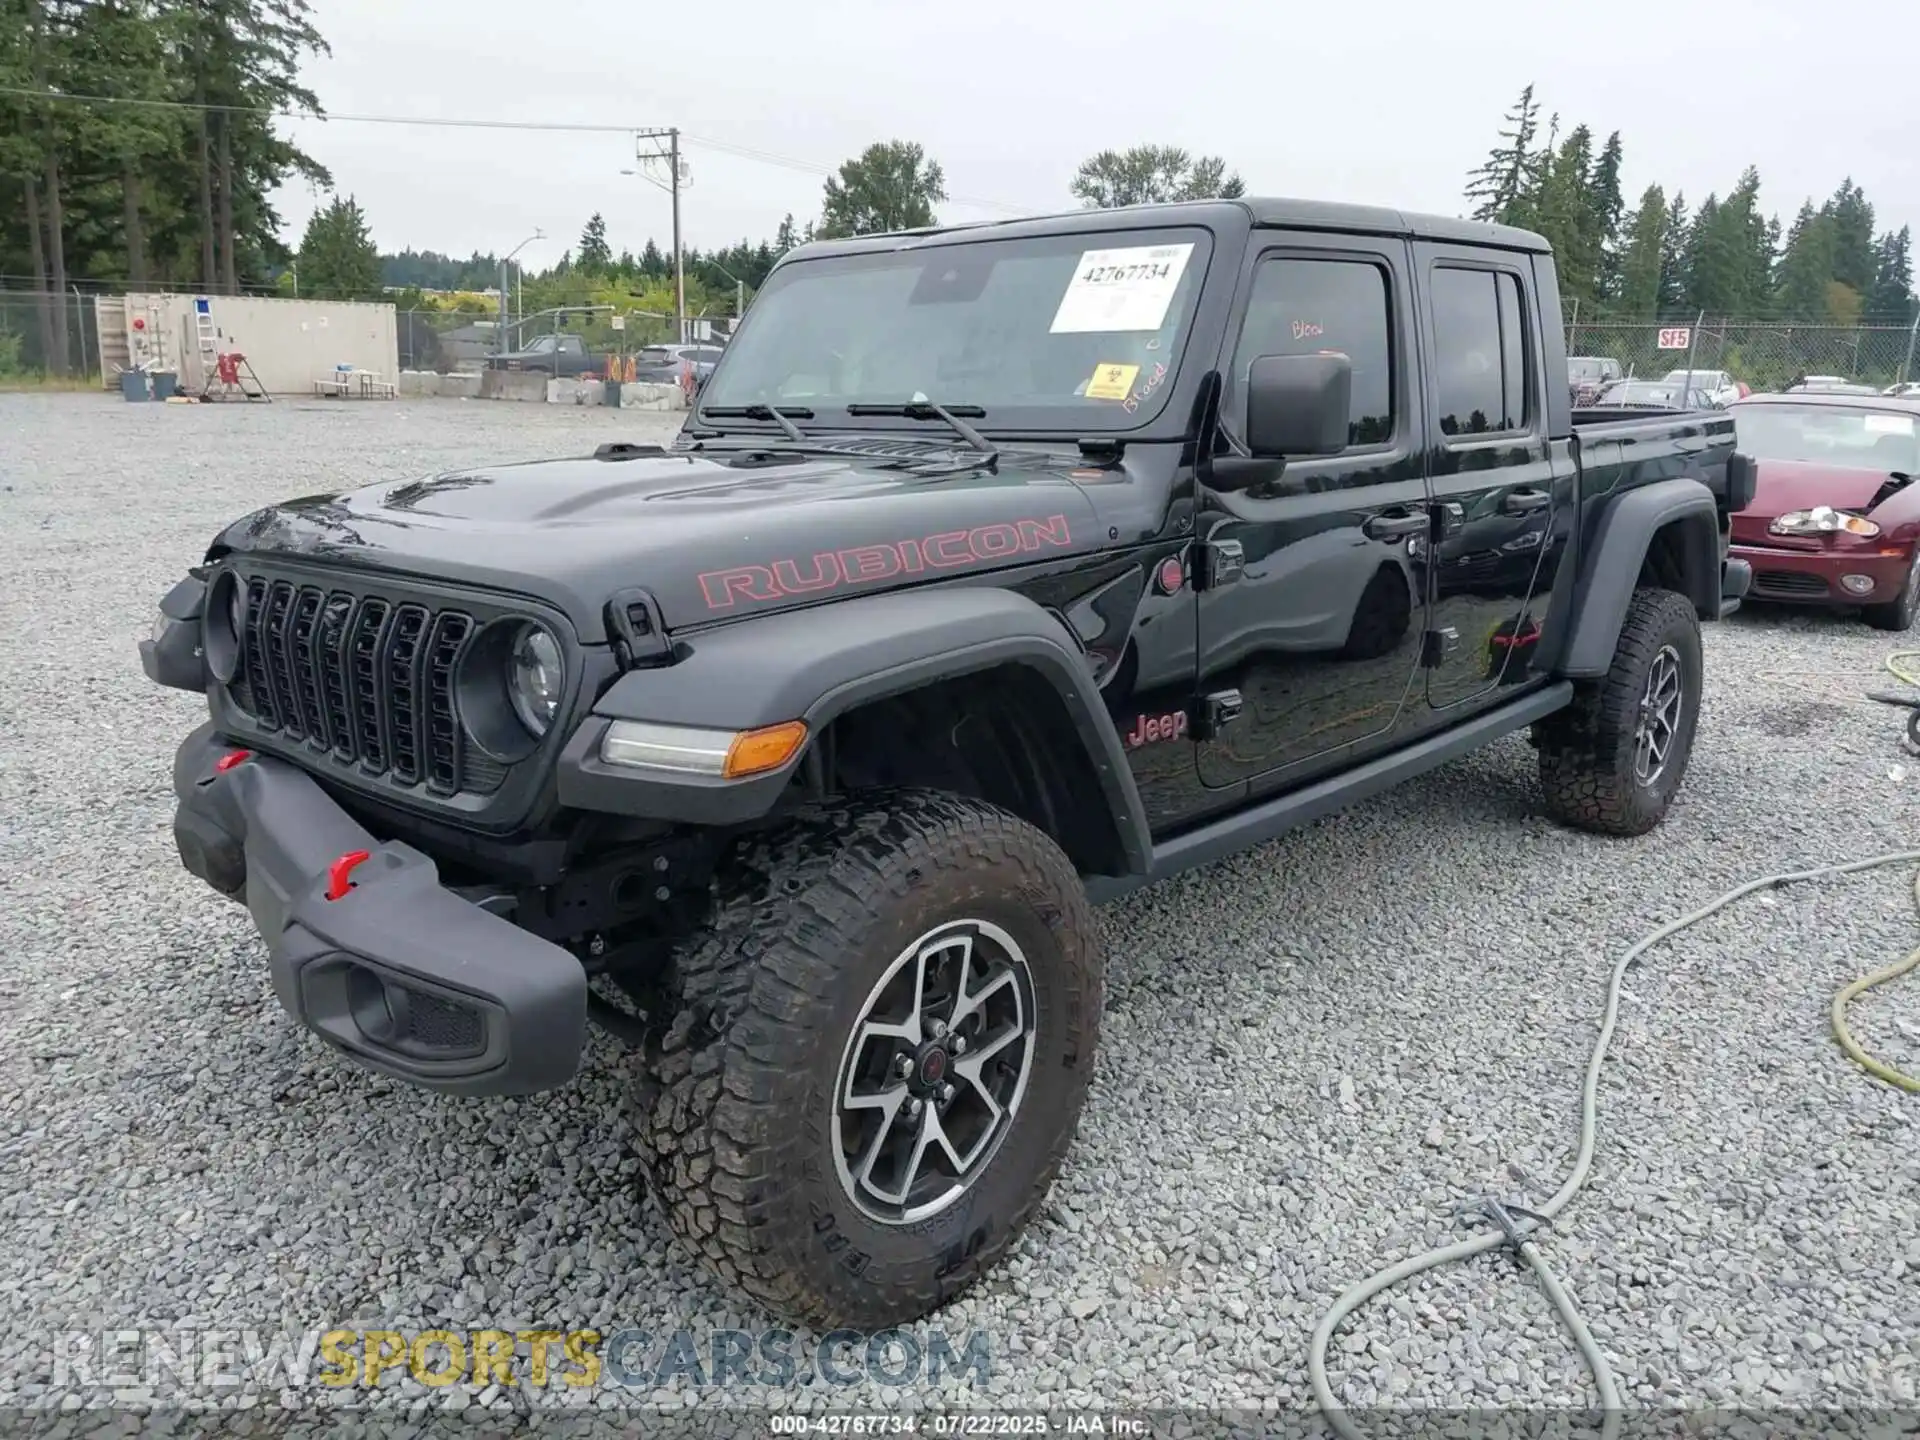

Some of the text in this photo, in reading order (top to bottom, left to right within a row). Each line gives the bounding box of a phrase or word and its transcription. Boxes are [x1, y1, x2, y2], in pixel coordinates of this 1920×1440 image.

[1083, 263, 1170, 282] 42767734
[1661, 330, 1687, 347] SF5
[697, 514, 1072, 609] RUBICON
[1126, 710, 1188, 746] Jeep
